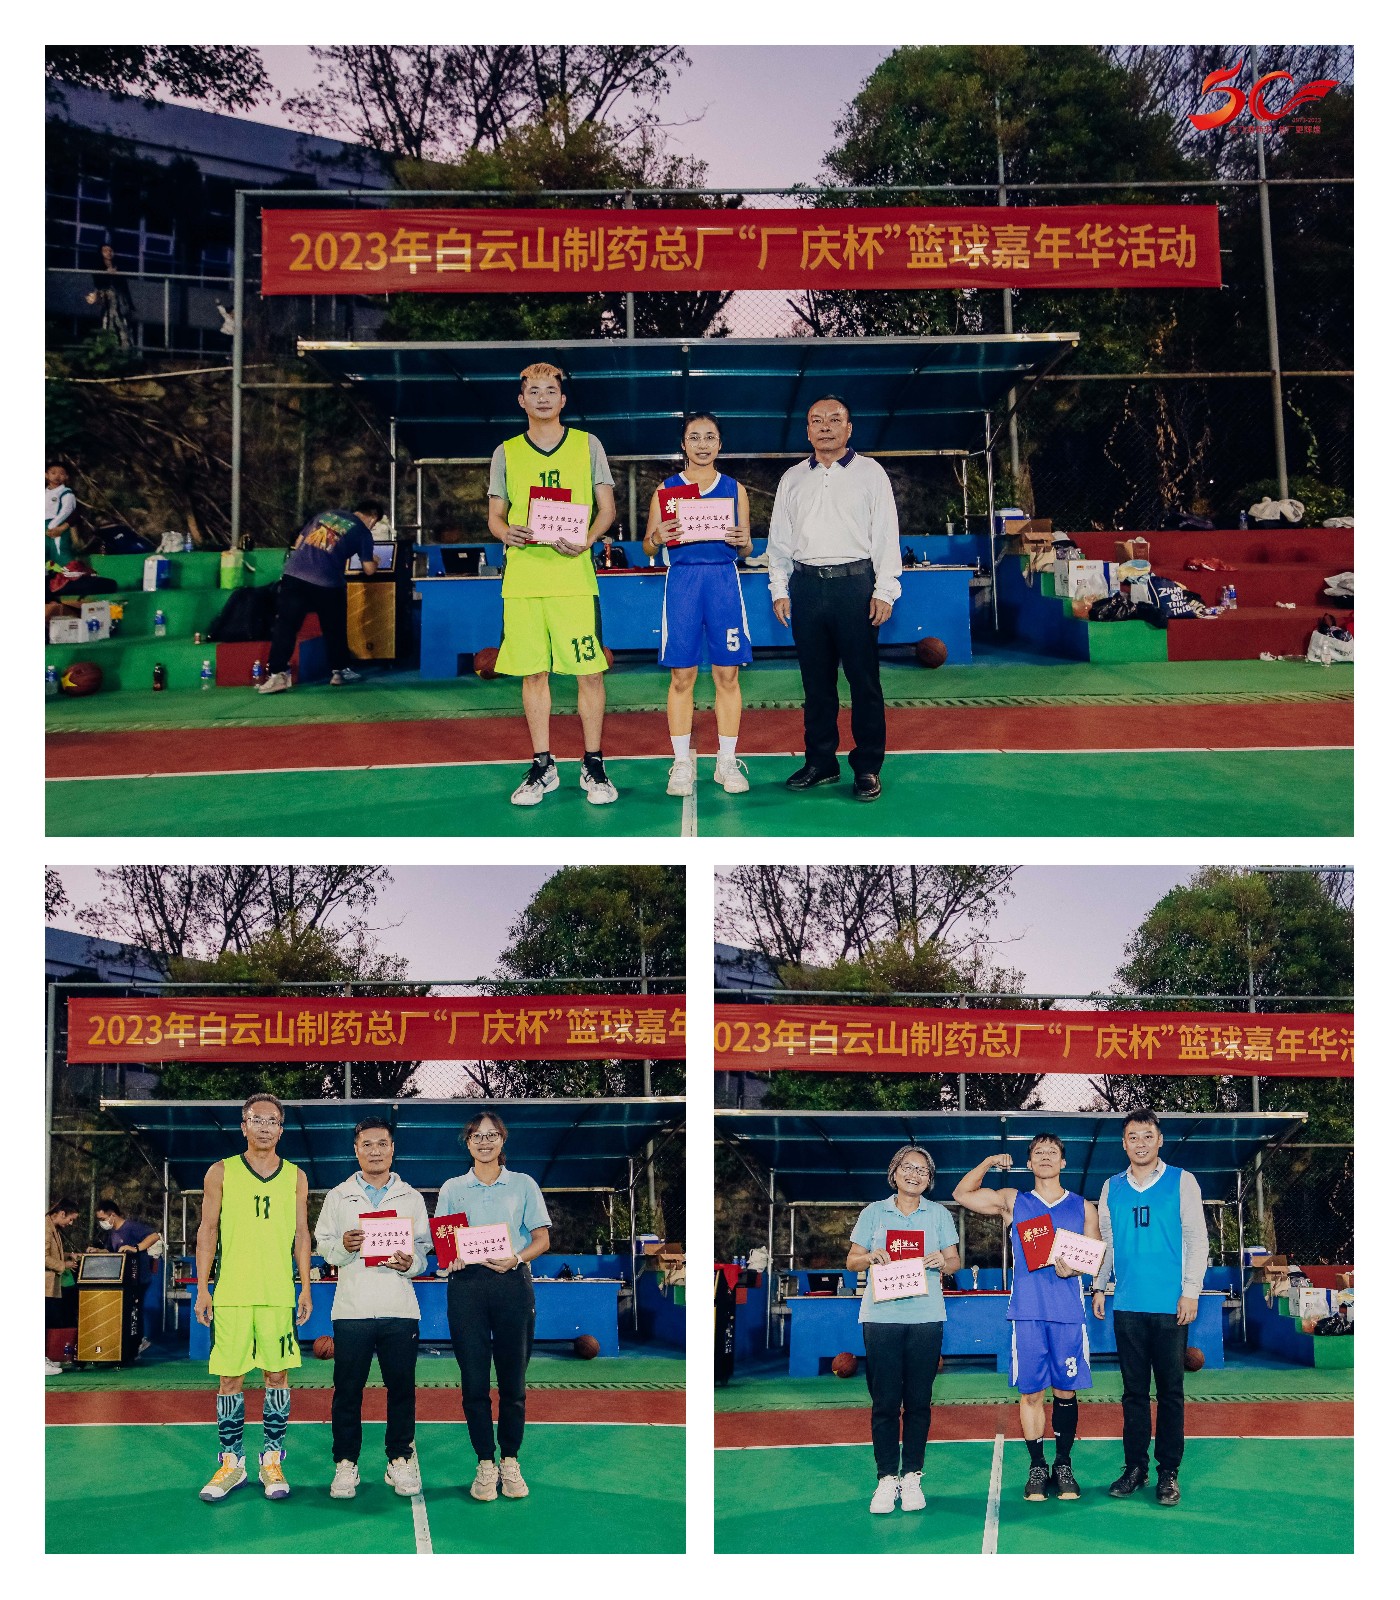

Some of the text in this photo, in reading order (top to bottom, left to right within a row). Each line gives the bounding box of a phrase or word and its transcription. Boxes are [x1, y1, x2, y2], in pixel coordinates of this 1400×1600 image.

[289, 223, 1196, 275] 2023年白云山制药总厂“厂庆杯”篮球嘉年华活动
[571, 635, 596, 663] 13
[726, 627, 741, 652] 5
[254, 1194, 270, 1219] 11
[1132, 1205, 1150, 1228] 10
[279, 1332, 294, 1359] 11
[1065, 1356, 1078, 1378] 3
